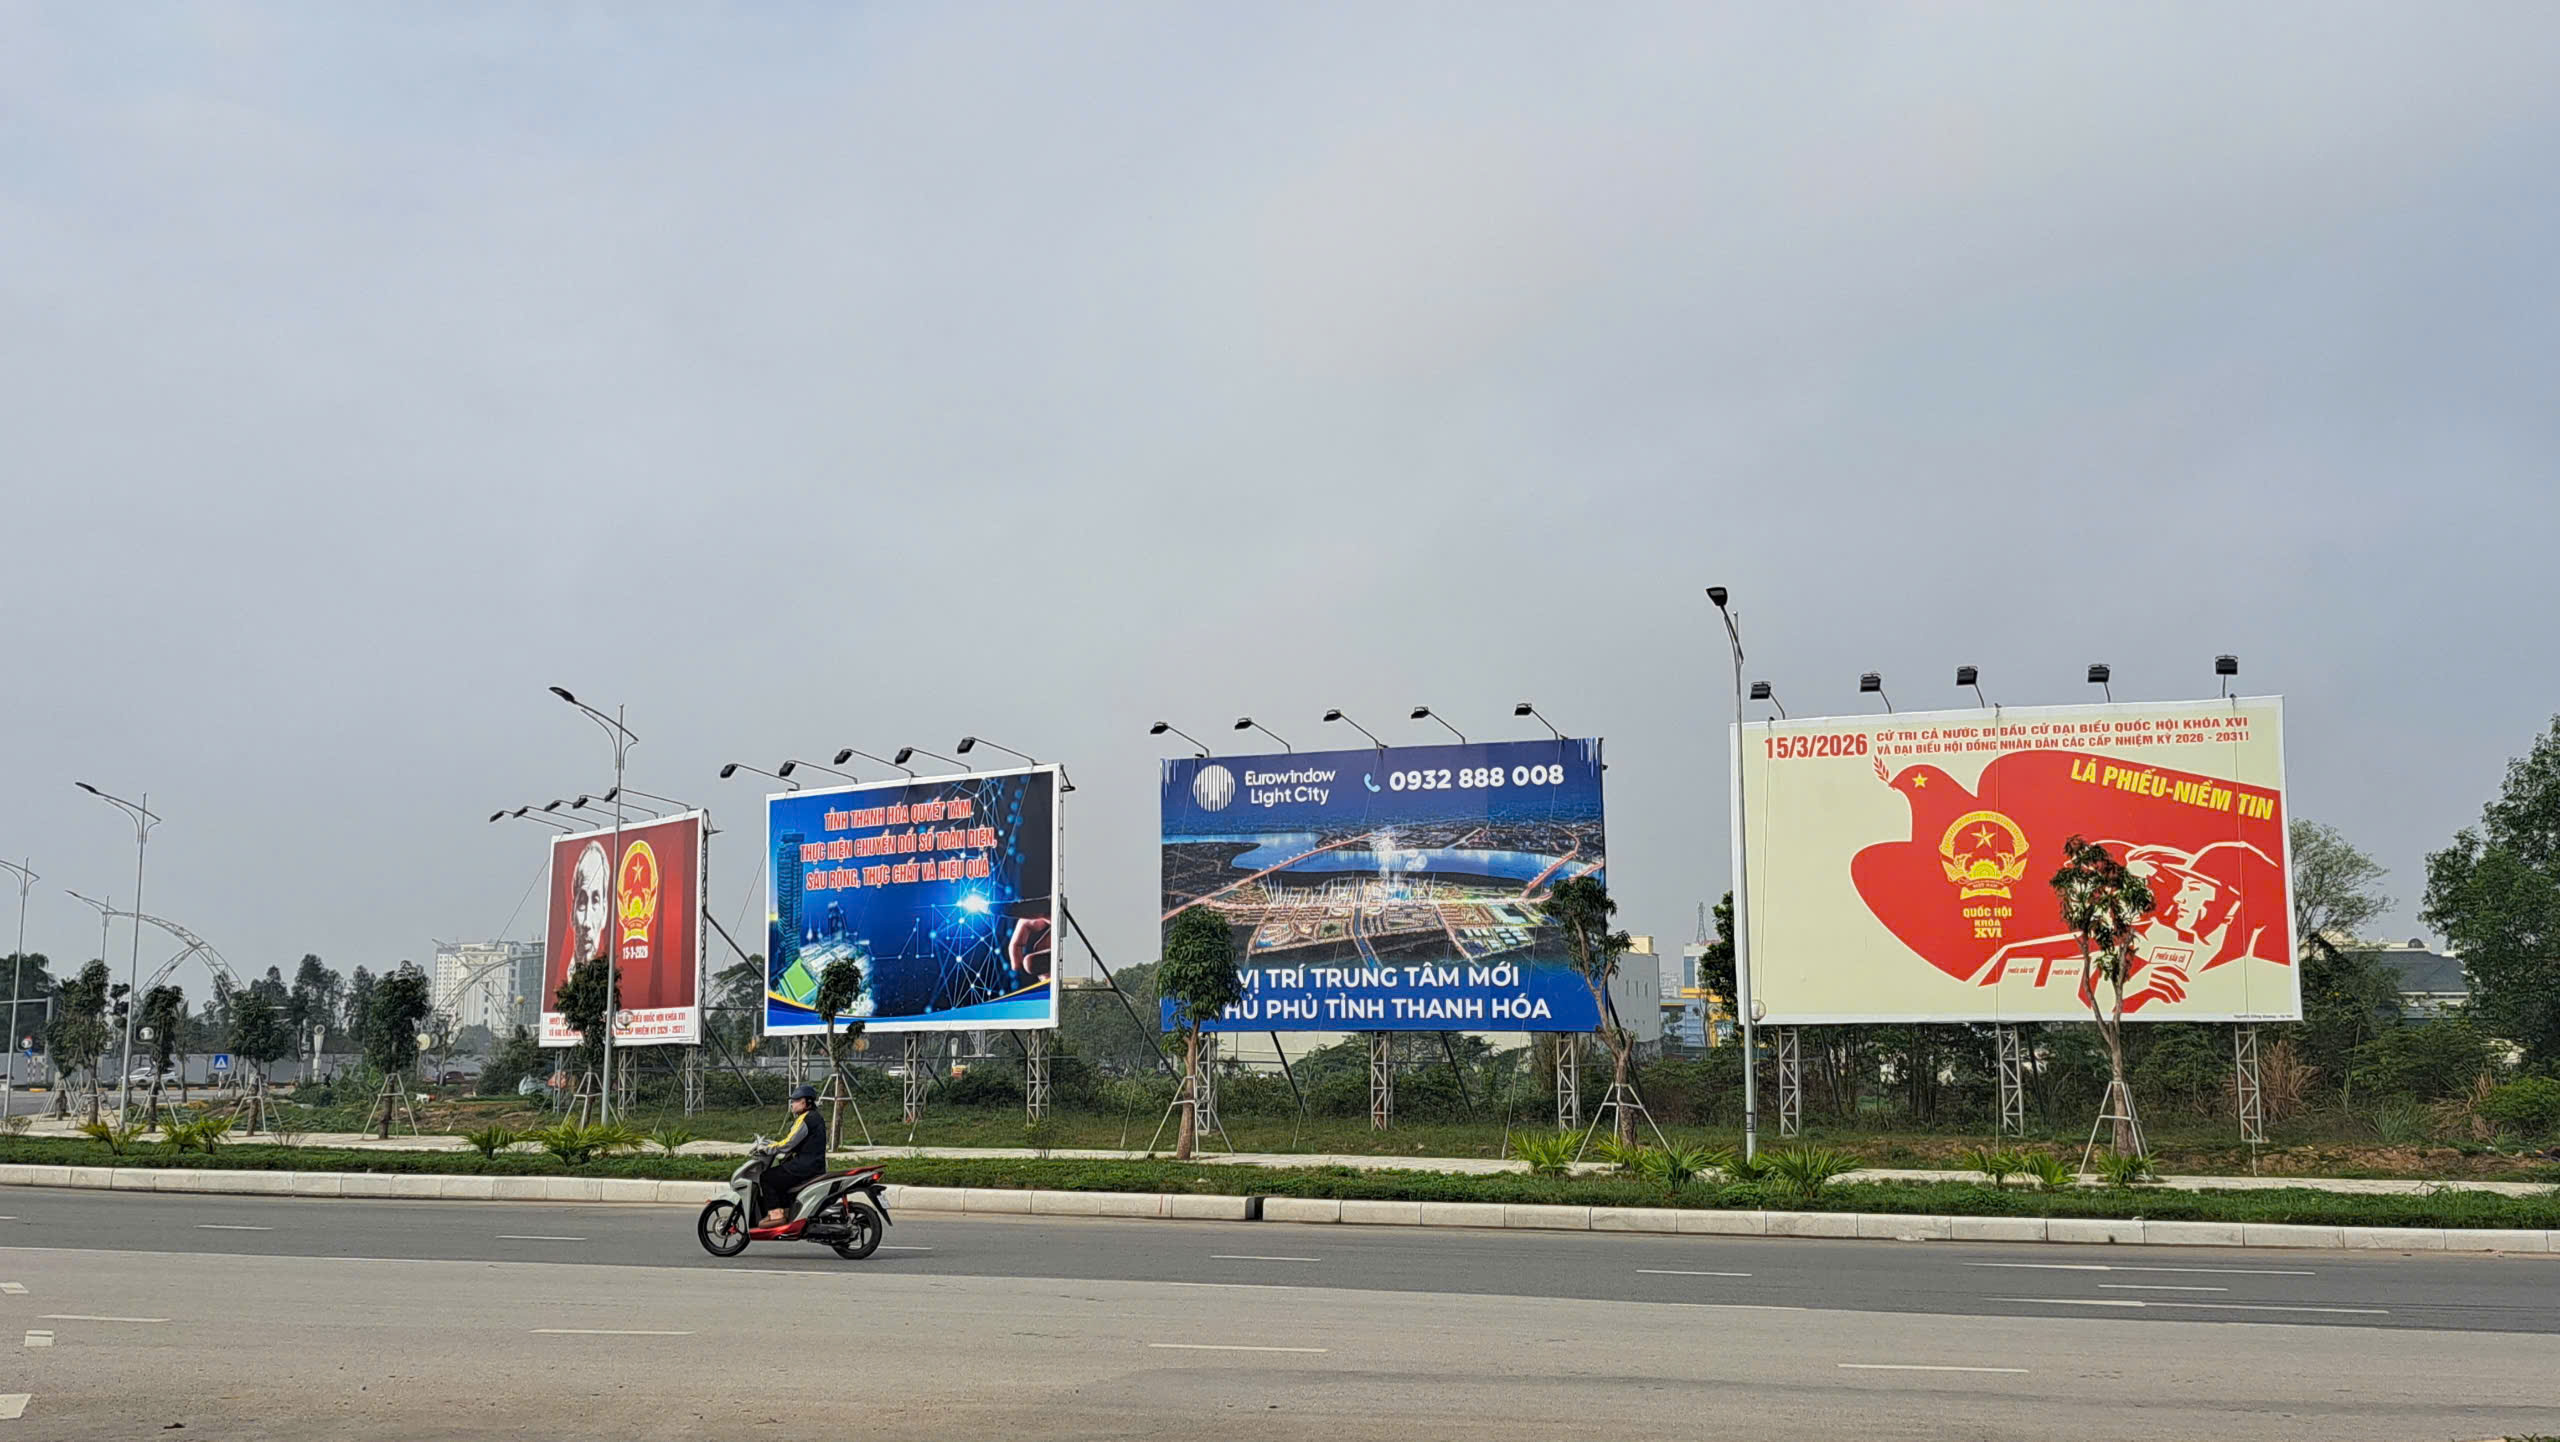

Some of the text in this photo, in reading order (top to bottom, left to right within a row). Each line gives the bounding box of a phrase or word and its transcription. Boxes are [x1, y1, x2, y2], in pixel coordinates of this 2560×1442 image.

[1876, 729, 1895, 741] CỬ
[1897, 731, 1917, 740] TRI
[1921, 728, 1939, 739] CẢ
[2031, 722, 2049, 734] CỬ
[2115, 718, 2151, 732] QUỐC
[2156, 718, 2178, 731] HỘI
[2183, 717, 2221, 729] KHÓA
[2225, 717, 2248, 727] XVI
[1764, 733, 1868, 759] 15/3/2026
[1877, 744, 1891, 755] VÀ
[1944, 741, 1963, 753] HỘI
[2062, 736, 2085, 747] CÁC
[2115, 734, 2153, 747] NHIỆM
[2176, 733, 2204, 743] 2026
[2216, 731, 2249, 742] 2031!
[1245, 767, 1336, 786] Eurowindow
[1389, 764, 1564, 791] 0932 888 008
[2071, 758, 2096, 784] LÁ
[2238, 793, 2274, 820] TIN
[1251, 786, 1329, 808] Light City
[824, 806, 849, 831] TỈNH
[850, 807, 886, 829] THANH
[887, 801, 909, 825] HÓA
[911, 796, 945, 824] QUYẾT
[800, 841, 826, 865] THỰC
[827, 837, 853, 863] HIỆN
[919, 826, 935, 852] SỐ
[936, 827, 966, 850] TOÀN
[806, 867, 827, 891] SÂU
[863, 864, 890, 888] THỰC
[892, 857, 920, 884] CHẤT
[921, 858, 937, 881] VÀ
[938, 856, 965, 884] HIỆU
[966, 852, 989, 880] QUẢ
[1963, 904, 2012, 919] QUỐC HỘI
[1974, 928, 2003, 938] XVI
[1236, 961, 1519, 994] VỊ TRÍ TRUNG TÂM MỚI
[1224, 992, 1552, 1019] HỦ PHỦ TỈNH THANH HÓA
